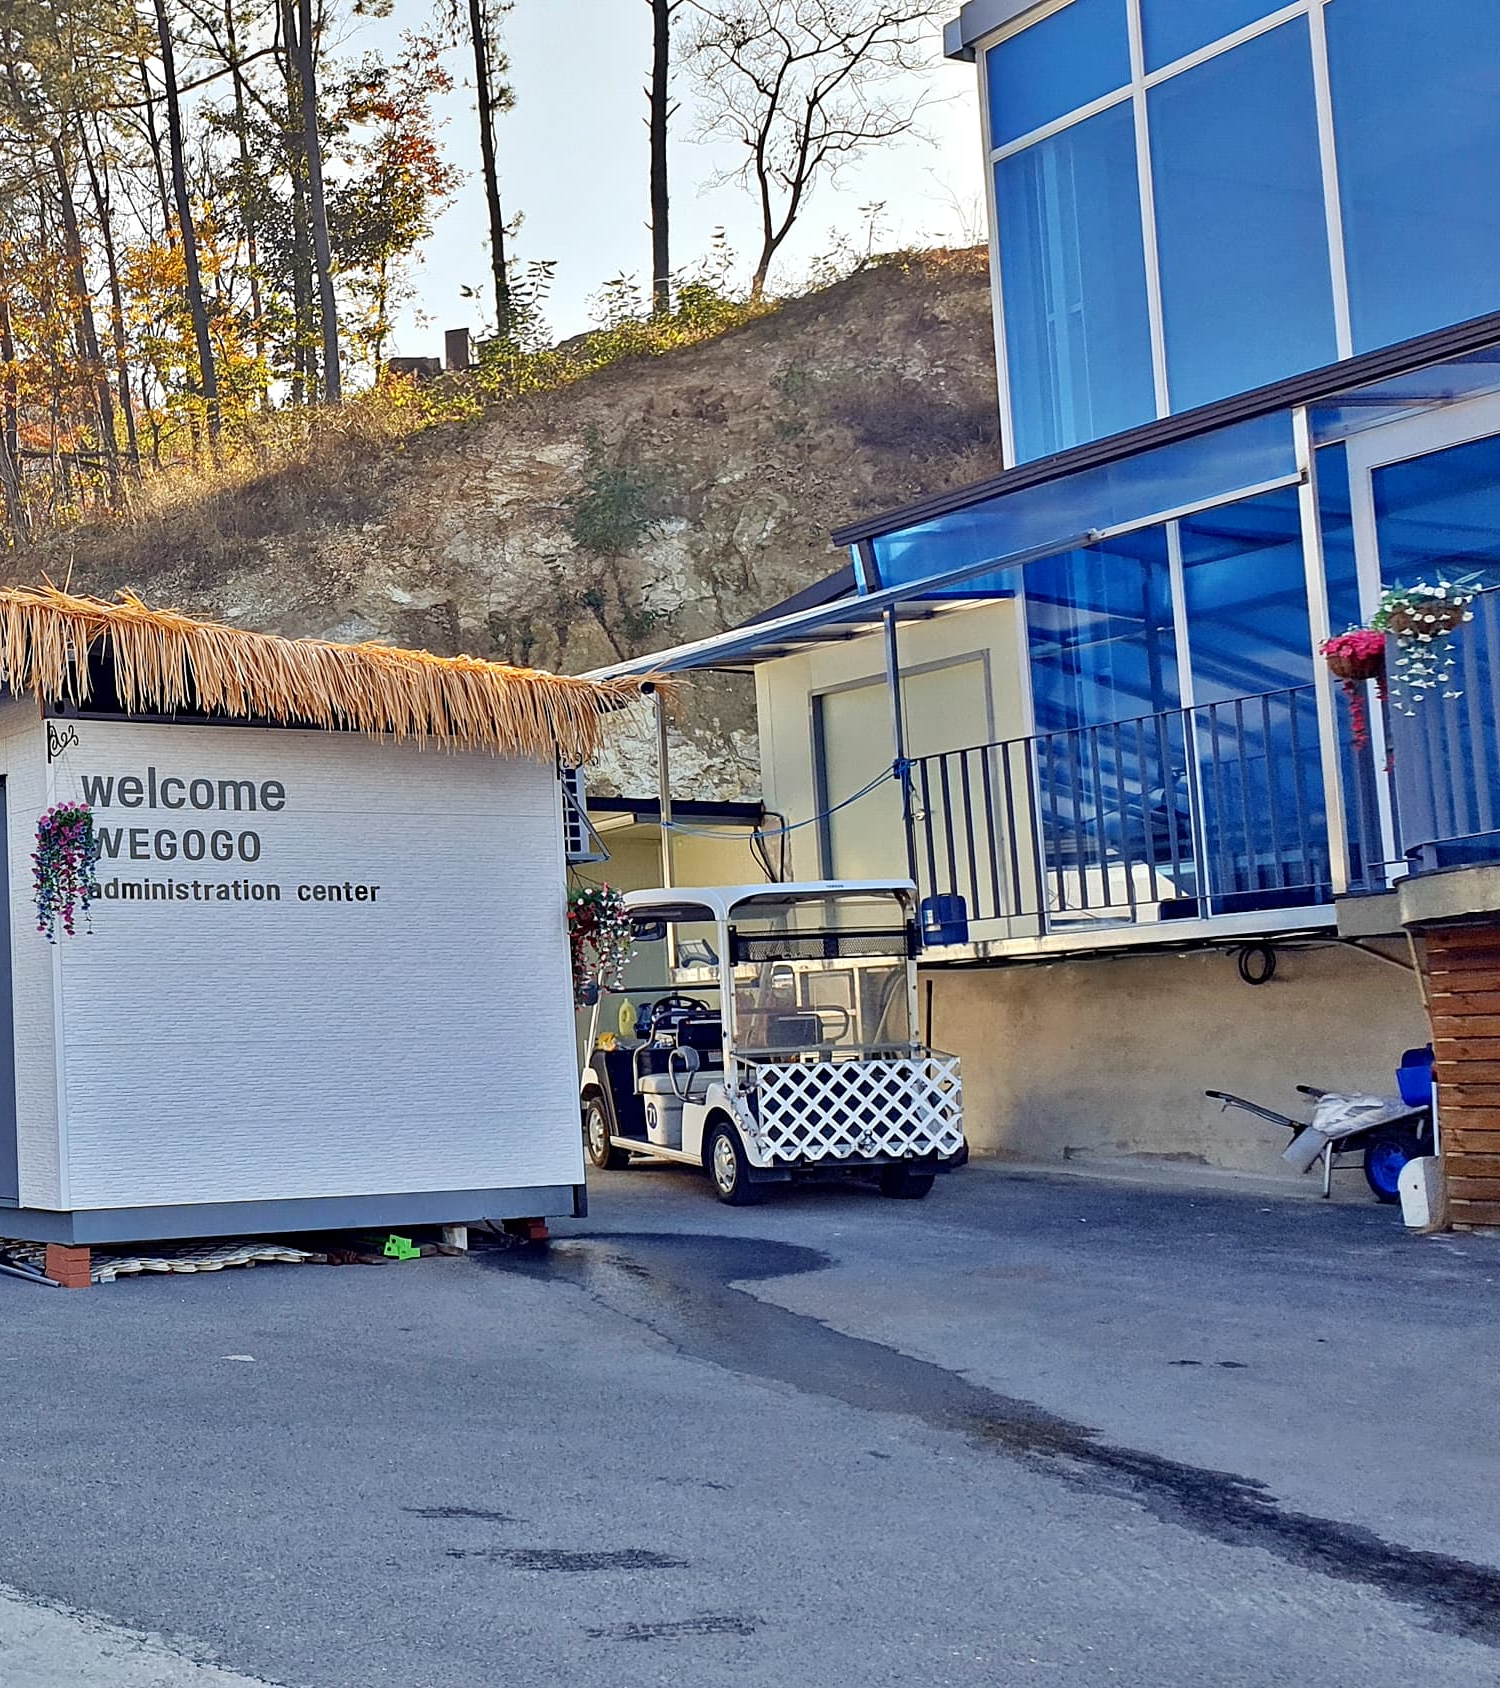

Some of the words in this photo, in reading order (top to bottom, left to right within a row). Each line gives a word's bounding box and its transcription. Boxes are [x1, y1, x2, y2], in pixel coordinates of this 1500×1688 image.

[81, 766, 286, 812] welcome
[90, 826, 262, 862] WEGOGO
[90, 877, 281, 902] administration
[297, 880, 381, 902] center
[647, 1107, 656, 1124] 71
